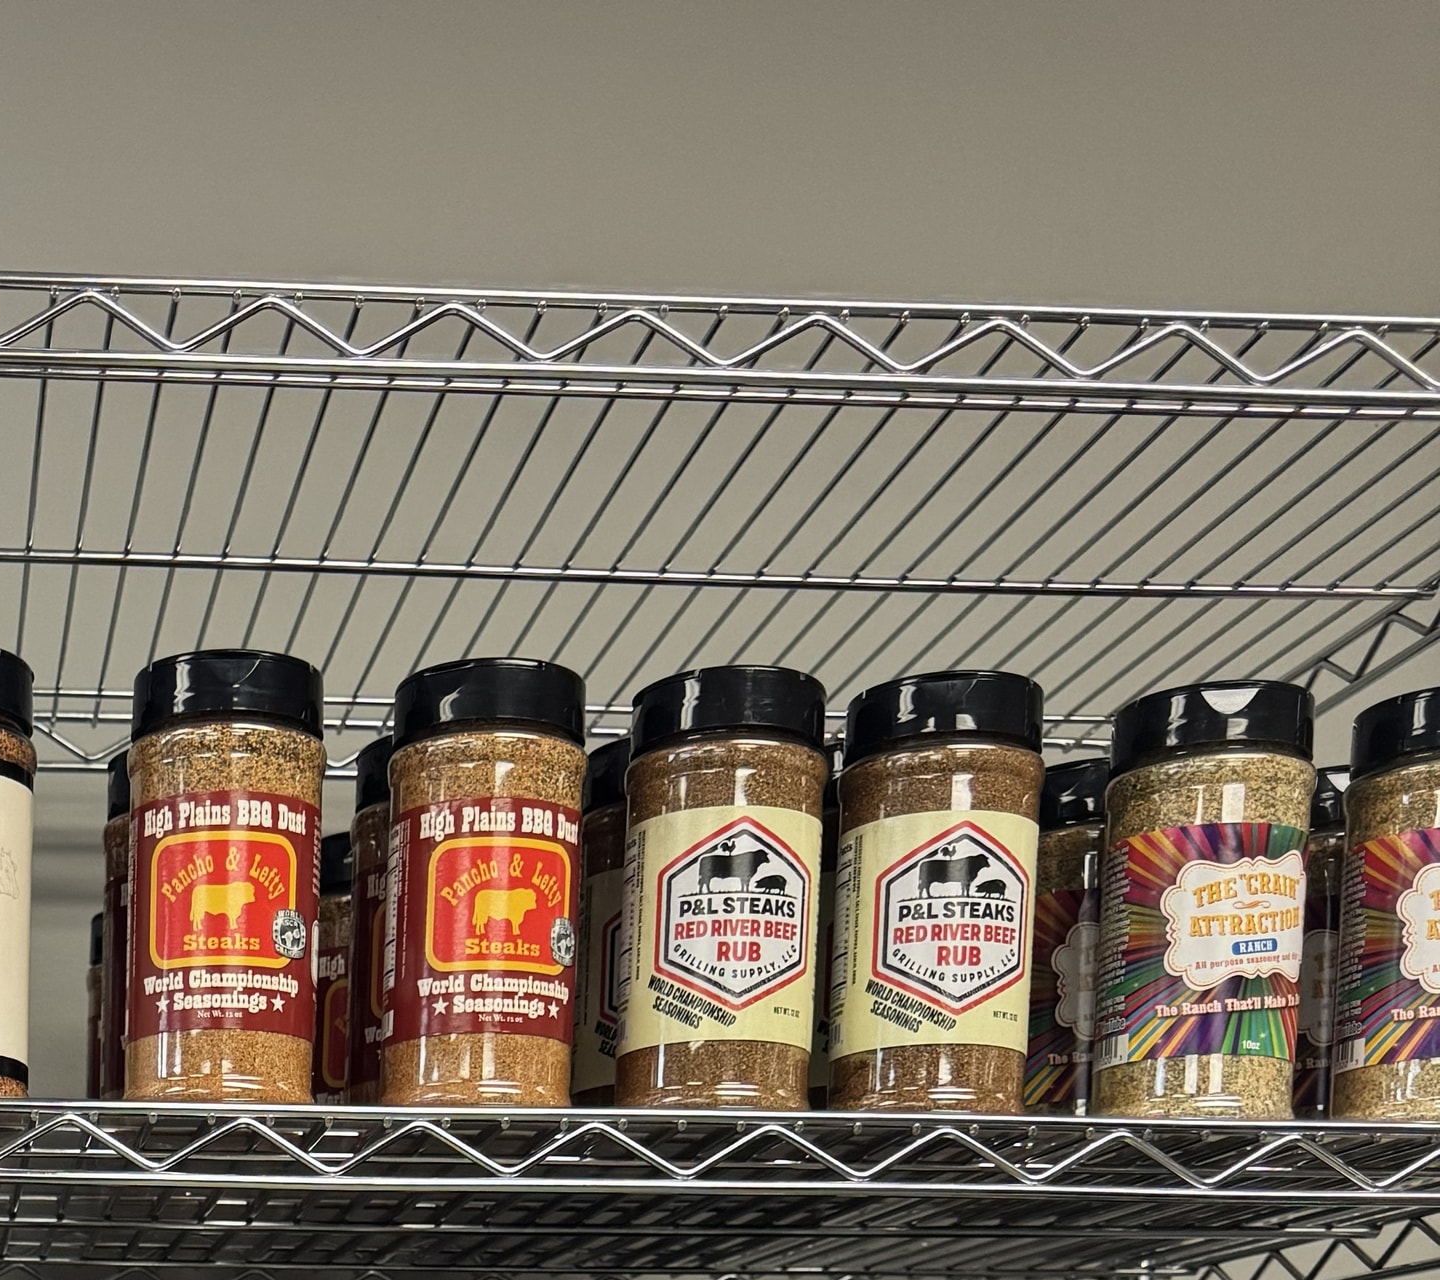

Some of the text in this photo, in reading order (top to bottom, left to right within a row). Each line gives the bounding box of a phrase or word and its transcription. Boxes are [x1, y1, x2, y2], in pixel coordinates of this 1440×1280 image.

[144, 800, 306, 839] High Plains BBQ Dust
[160, 847, 285, 903] Pancho & Lefty
[1192, 877, 1237, 908] THE
[679, 897, 795, 918] P&L STEAKS
[898, 902, 1015, 922] P&L STEAKS
[673, 918, 798, 941] RED RIVER BEEF
[1189, 906, 1300, 937] ATTRACTION
[183, 934, 260, 951] Steaks
[892, 924, 1016, 945] RED RIVER BEEF
[716, 939, 762, 962] RUB
[935, 945, 981, 967] RUB
[1239, 941, 1272, 953] RANCH
[673, 945, 726, 978] GRILLING
[1195, 958, 1243, 969] All purpose
[144, 969, 299, 998] World Championship
[173, 991, 268, 1013] Seasonings
[647, 974, 738, 1028] WORLD CHAMPIONSHIP
[1155, 996, 1261, 1018] The Ranch That'll
[652, 1000, 703, 1031] SEASONINGS
